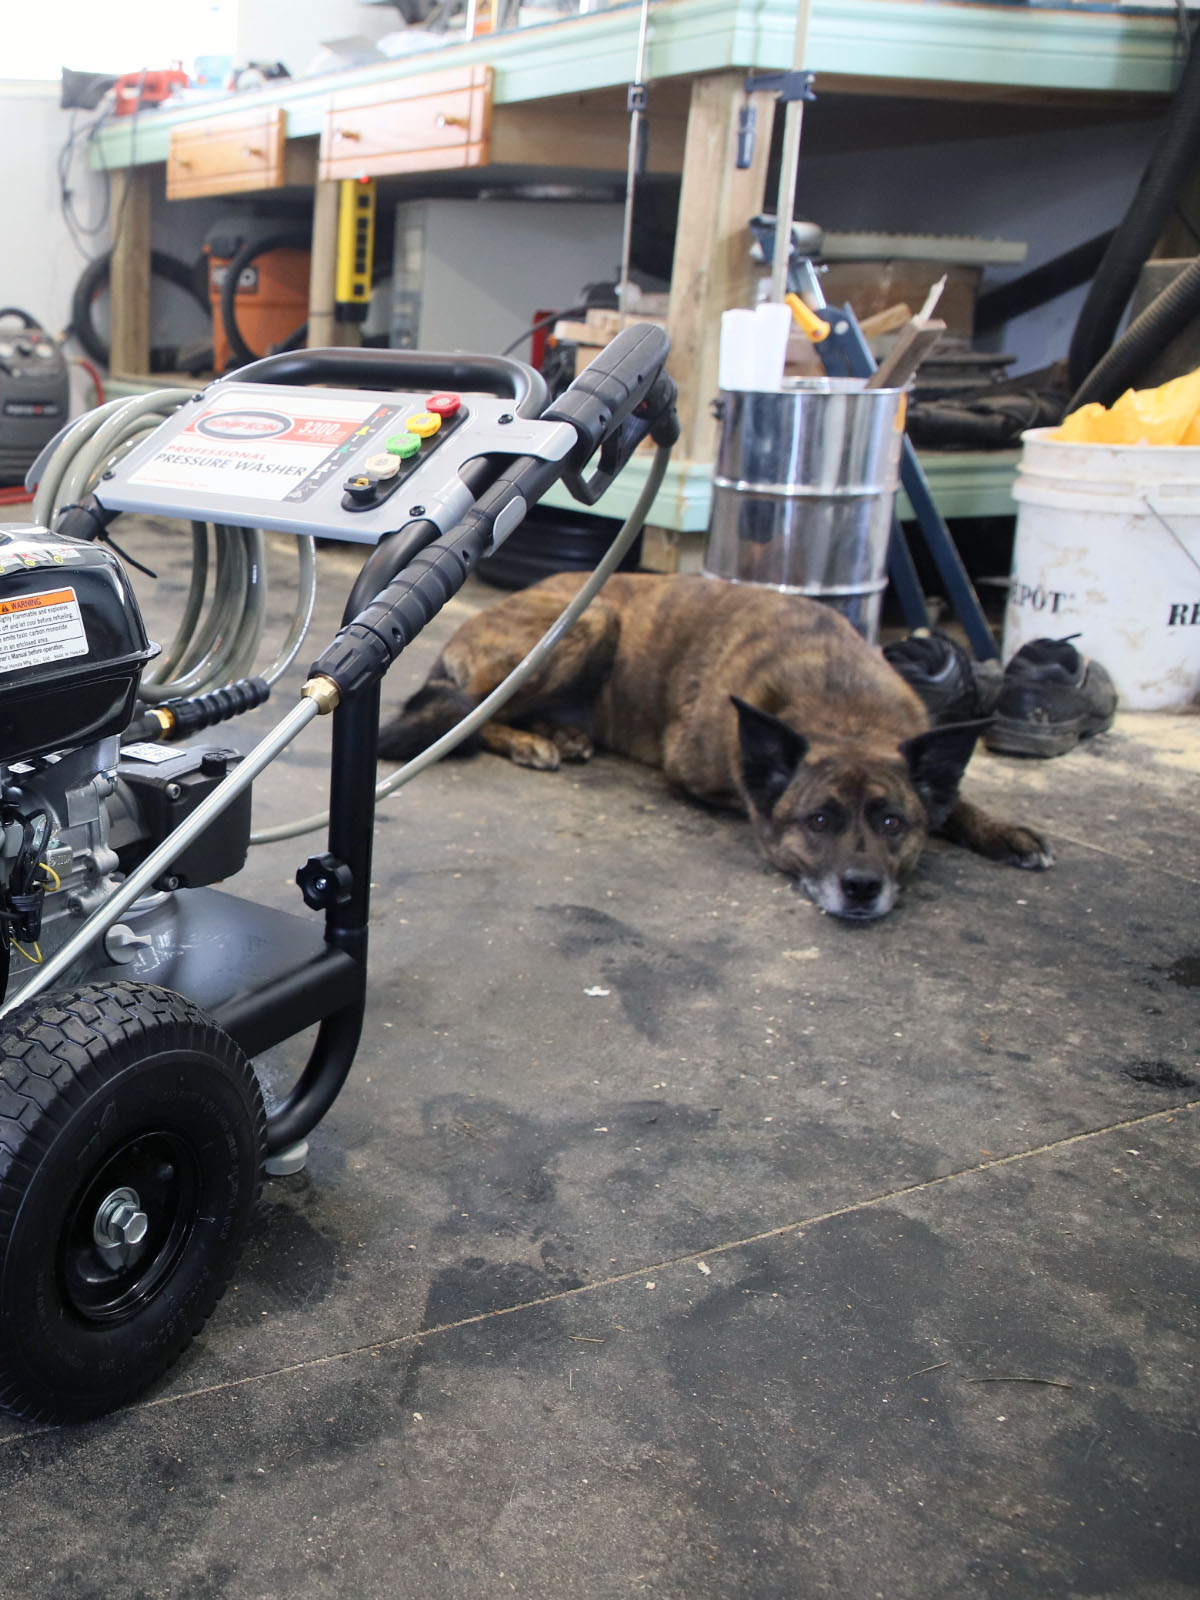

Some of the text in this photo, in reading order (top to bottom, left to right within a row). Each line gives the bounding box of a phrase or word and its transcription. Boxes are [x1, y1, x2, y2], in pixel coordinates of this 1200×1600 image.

[299, 421, 341, 435] 3300
[166, 444, 268, 461] PROFESSIONAL
[153, 453, 307, 477] PRESSURE WASHER
[11, 598, 42, 610] WARNING
[13, 610, 37, 620] flammable
[37, 616, 52, 624] before
[16, 639, 37, 648] enclosed
[11, 651, 27, 659] Manual
[28, 648, 42, 656] before
